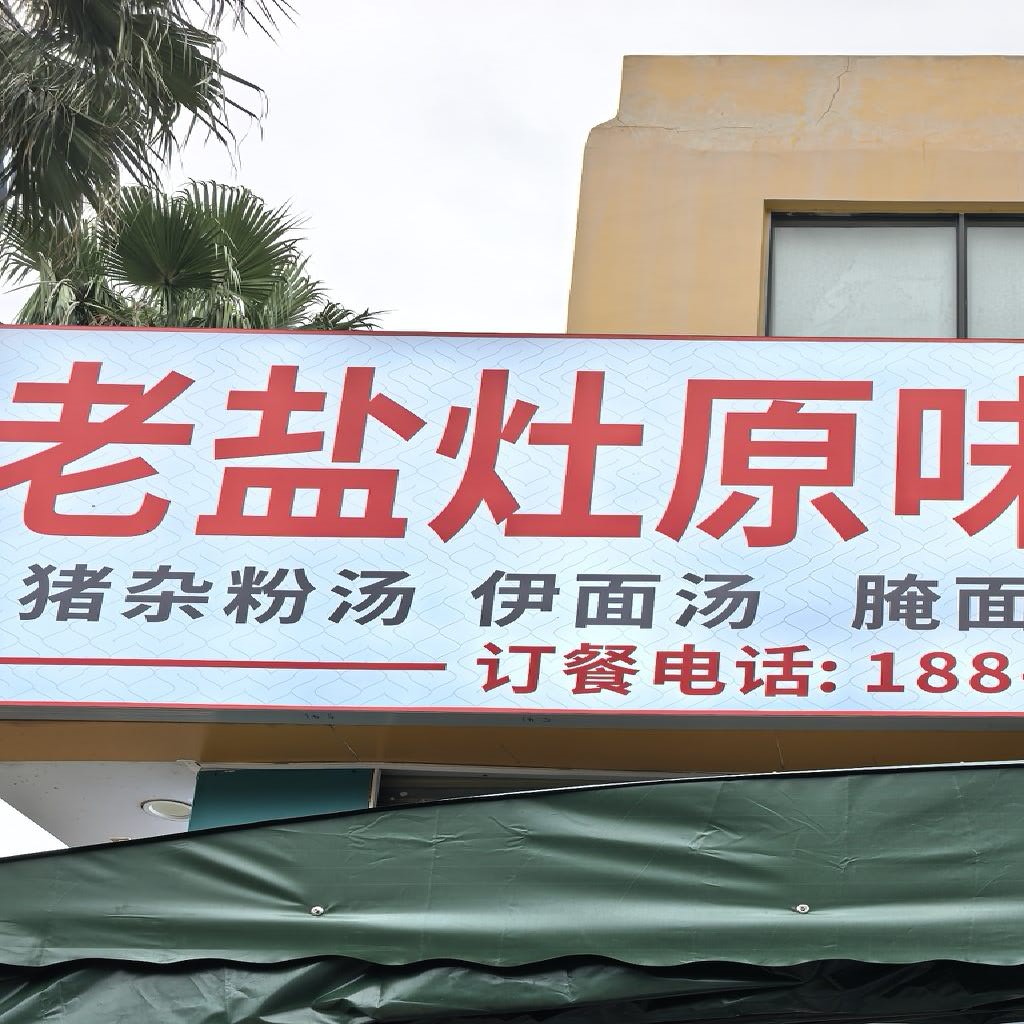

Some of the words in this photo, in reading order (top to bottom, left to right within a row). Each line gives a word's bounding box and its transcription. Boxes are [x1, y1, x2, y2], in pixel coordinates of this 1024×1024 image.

[18, 563, 416, 626] 猪杂粉汤
[471, 569, 761, 630] 伊面汤
[476, 642, 836, 697] 订餐电话:
